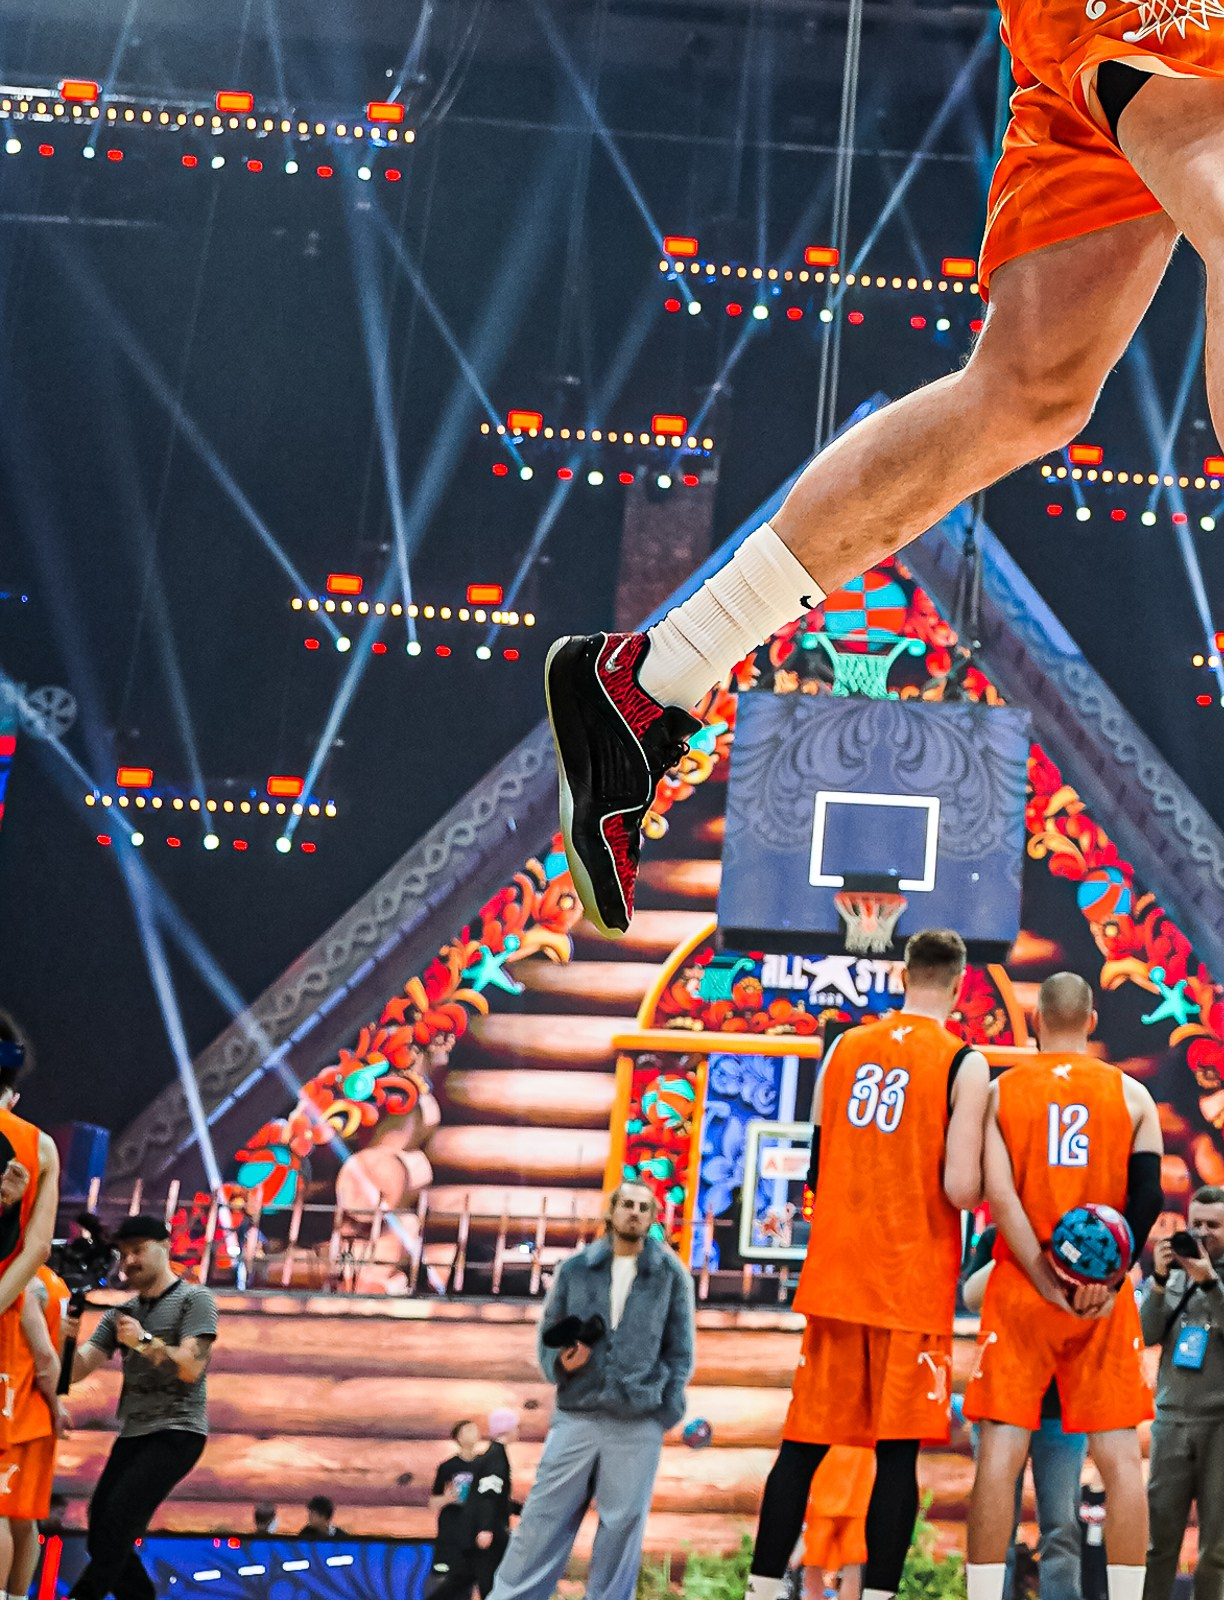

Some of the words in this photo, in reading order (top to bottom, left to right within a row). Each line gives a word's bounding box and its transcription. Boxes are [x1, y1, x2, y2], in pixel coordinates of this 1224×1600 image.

[760, 953, 809, 990] ALL
[855, 958, 907, 994] STA
[847, 1062, 910, 1134] 33
[1047, 1101, 1091, 1168] 12
